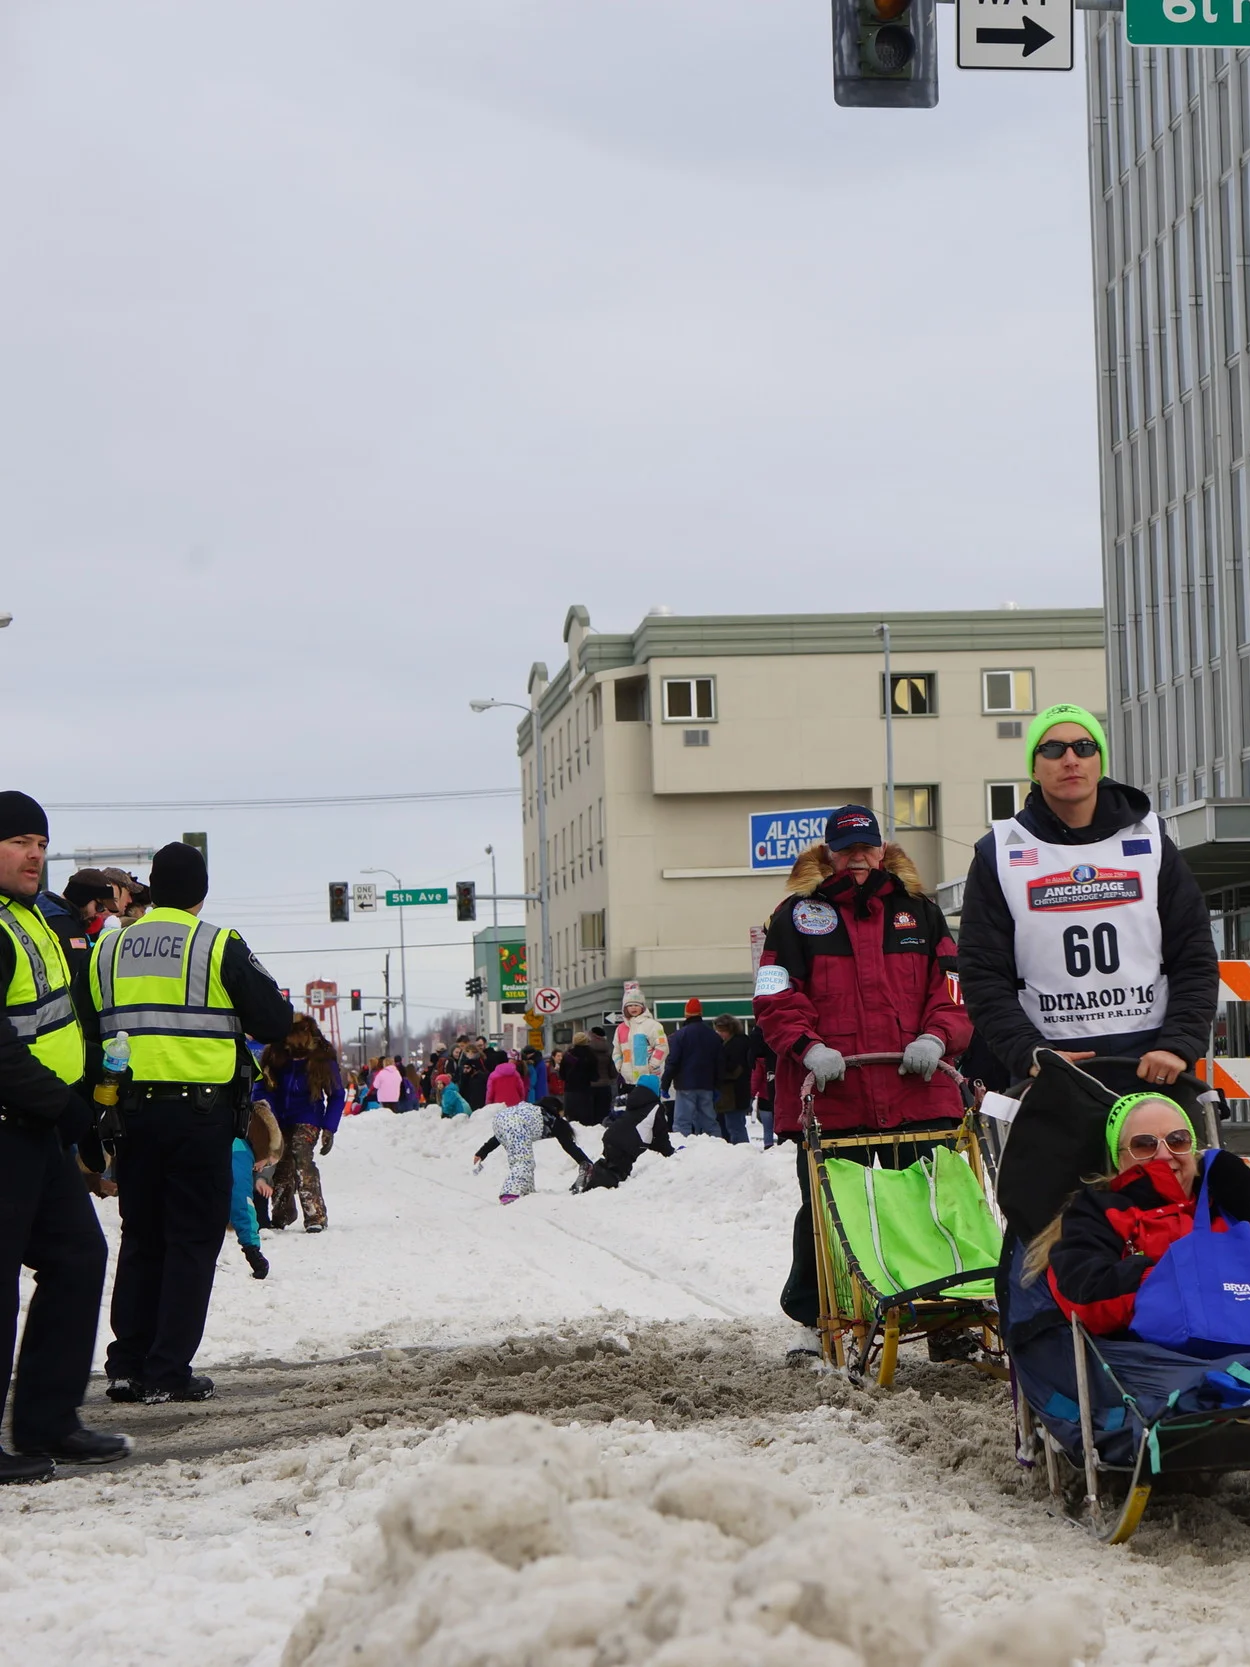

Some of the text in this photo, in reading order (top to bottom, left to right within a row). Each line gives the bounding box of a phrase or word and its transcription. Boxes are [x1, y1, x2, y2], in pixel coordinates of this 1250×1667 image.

[392, 892, 442, 903] 5th Ave
[1044, 881, 1125, 898] ANCHORAGE
[1034, 896, 1068, 906] CHRYSLER
[1072, 893, 1098, 902] DODGE
[121, 936, 184, 959] POLICE
[1063, 922, 1120, 978] 60
[1038, 987, 1126, 1012] IDITAROD
[1043, 1014, 1074, 1024] MUSH
[1075, 1011, 1105, 1022] WITH
